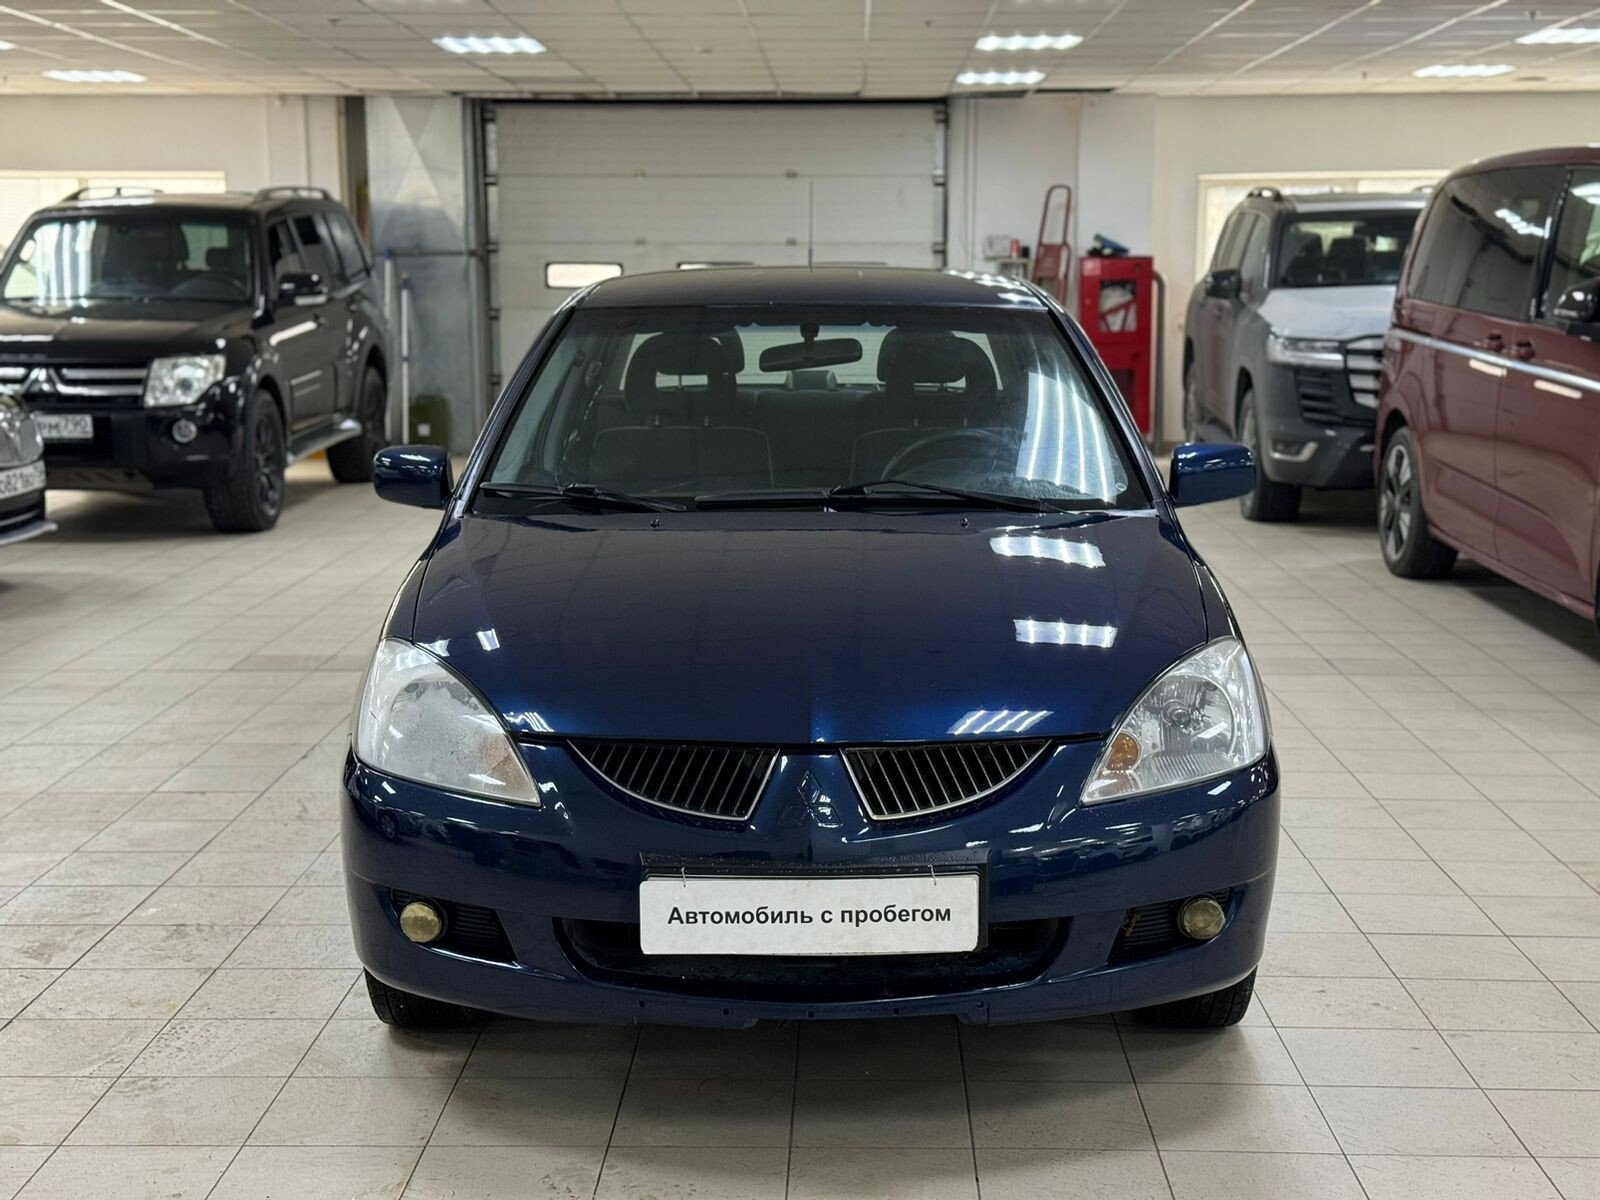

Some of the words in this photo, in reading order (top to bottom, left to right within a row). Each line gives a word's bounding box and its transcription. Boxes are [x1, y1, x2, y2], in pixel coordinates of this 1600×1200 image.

[667, 906, 813, 925] Автомобиль
[820, 910, 833, 924] с
[840, 904, 951, 928] пробегом
